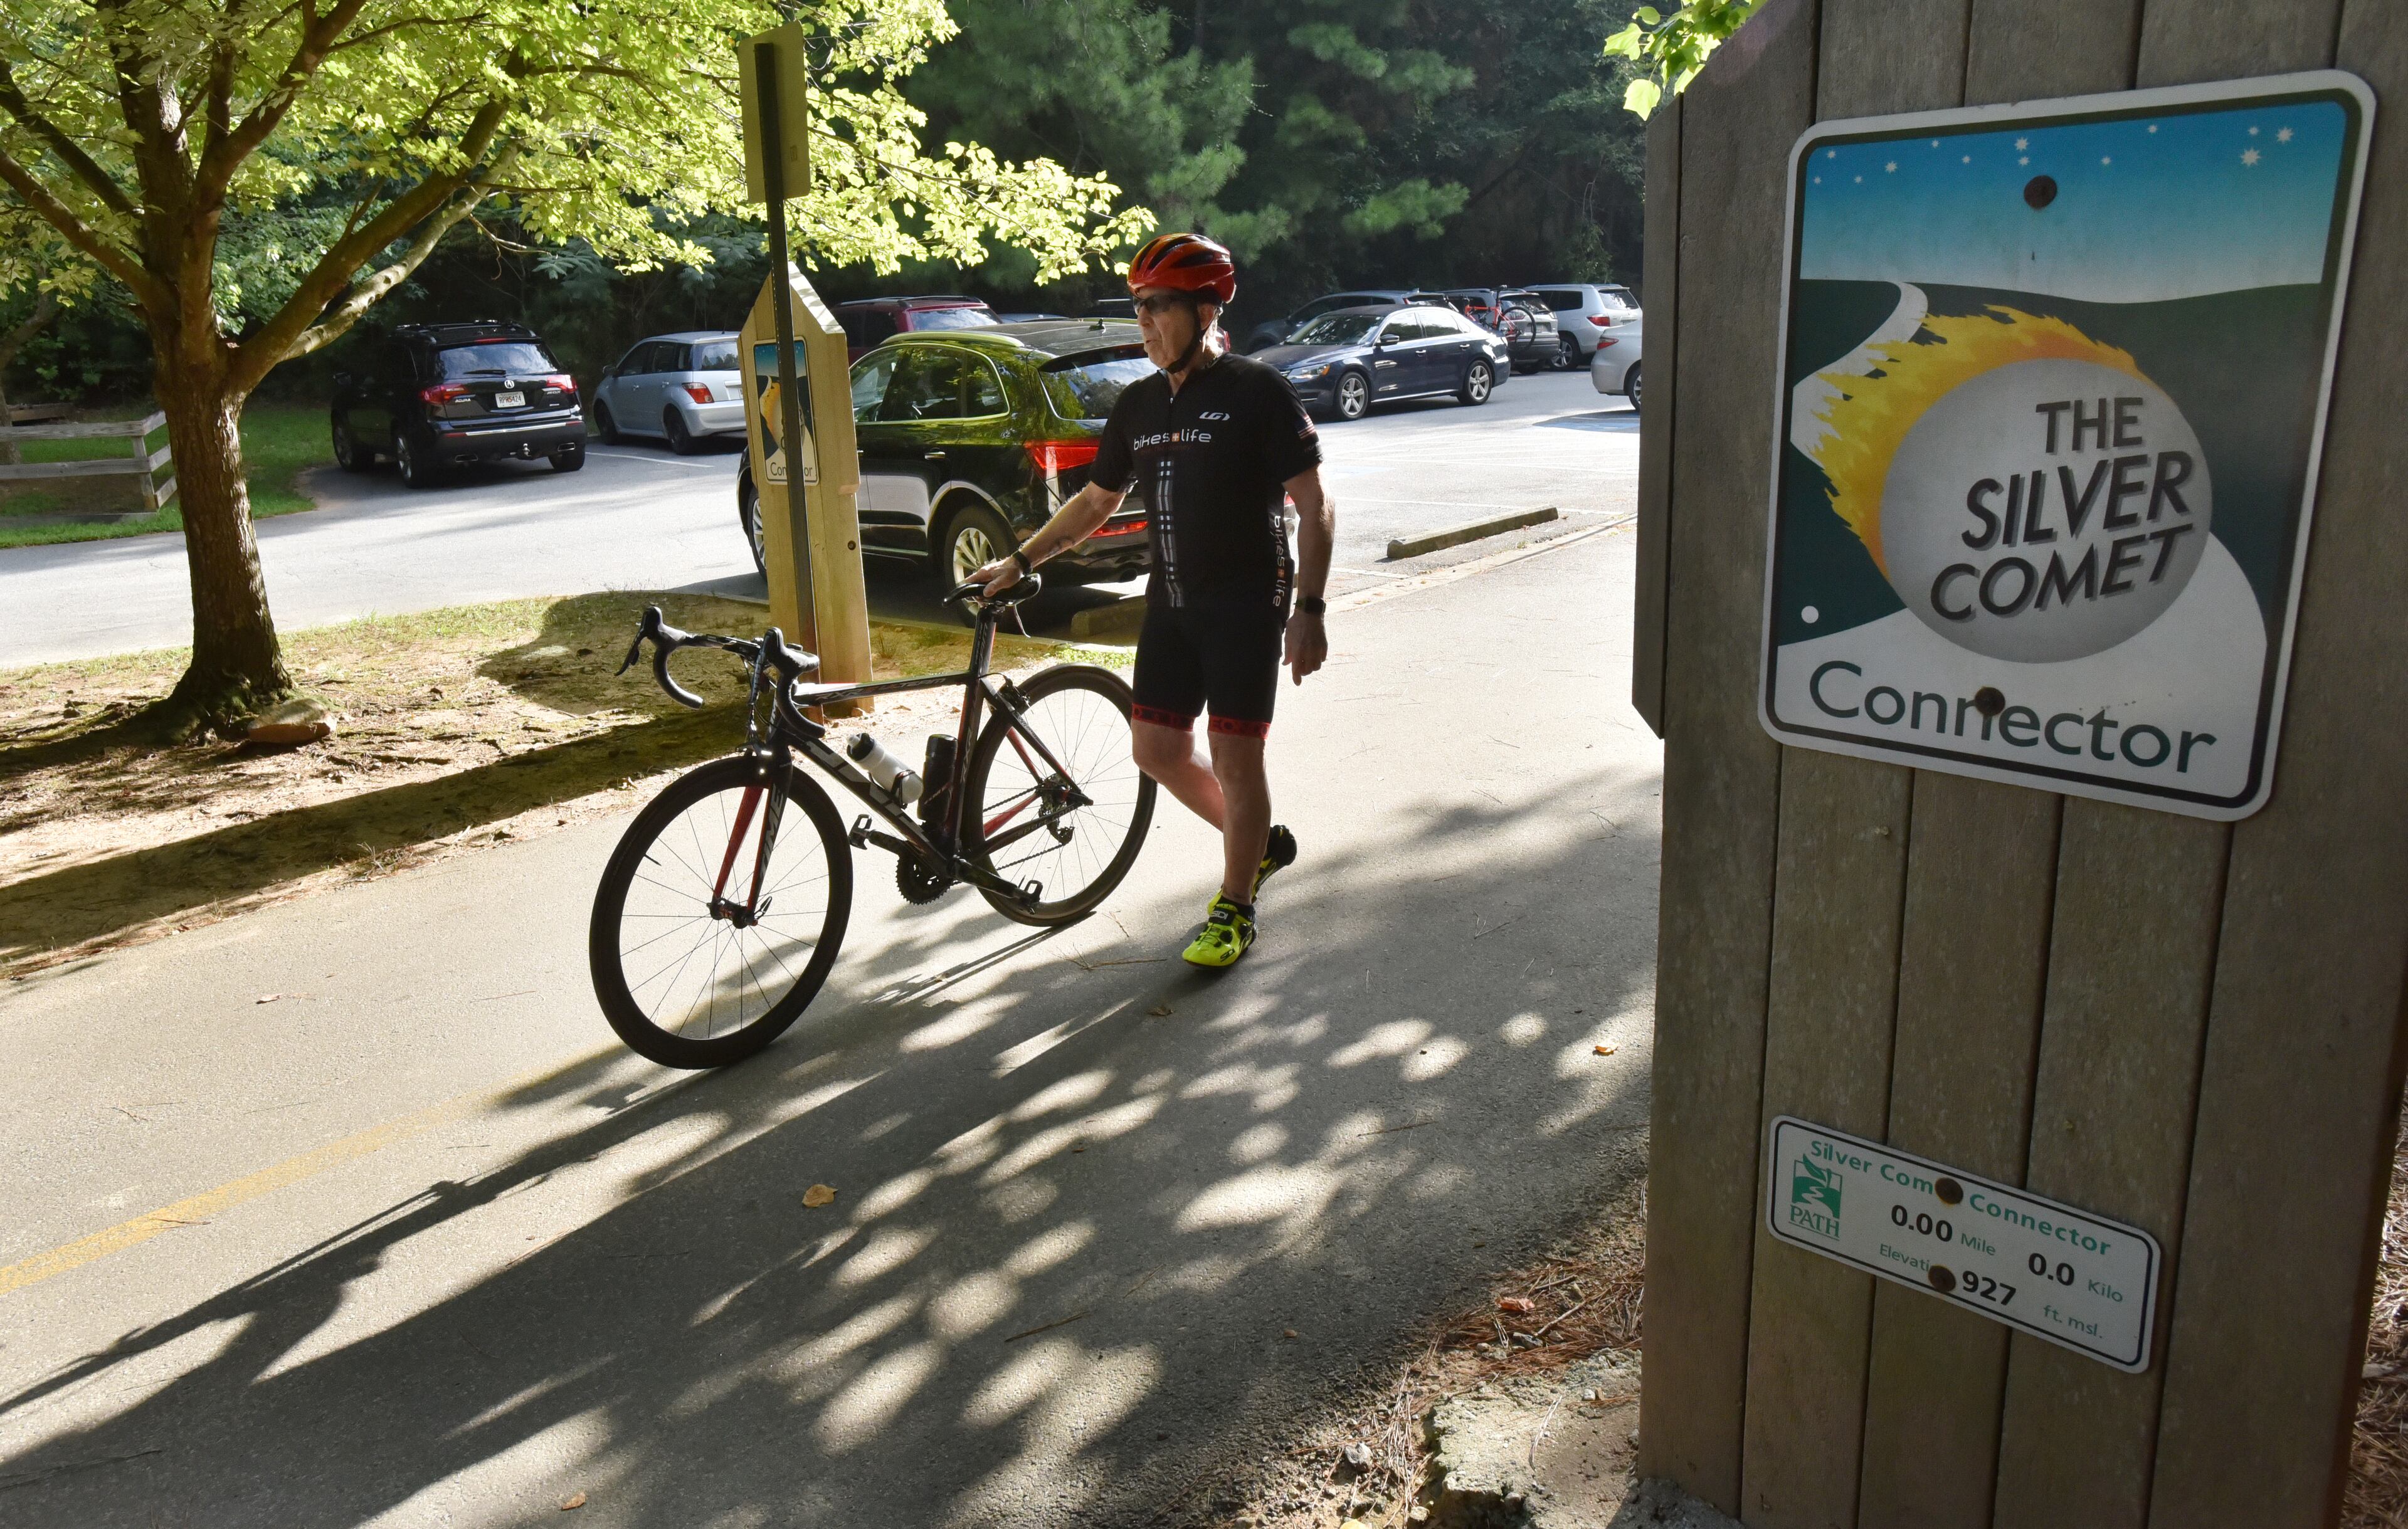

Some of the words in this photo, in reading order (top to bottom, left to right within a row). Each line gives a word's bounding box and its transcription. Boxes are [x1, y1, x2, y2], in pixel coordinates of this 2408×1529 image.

[770, 461, 813, 477] Conor
[2036, 397, 2143, 454] THE
[1962, 450, 2193, 551] SILVER
[1931, 523, 2194, 622] COMET
[1809, 659, 2217, 774] Connector
[1790, 1204, 1841, 1237] PATH
[1810, 1140, 1872, 1174] Silver
[1880, 1164, 1935, 1195] Com
[1969, 1194, 2111, 1255] Connector
[1879, 1243, 1931, 1273] Elevati
[1962, 1270, 2017, 1306] 927
[2044, 1305, 2062, 1323] ft.
[2069, 1316, 2103, 1339] msl.
[1891, 1204, 1953, 1243] 0.00
[1961, 1232, 1996, 1256] Mile
[2028, 1253, 2075, 1286] 0.0
[2088, 1279, 2123, 1303] Kilo
